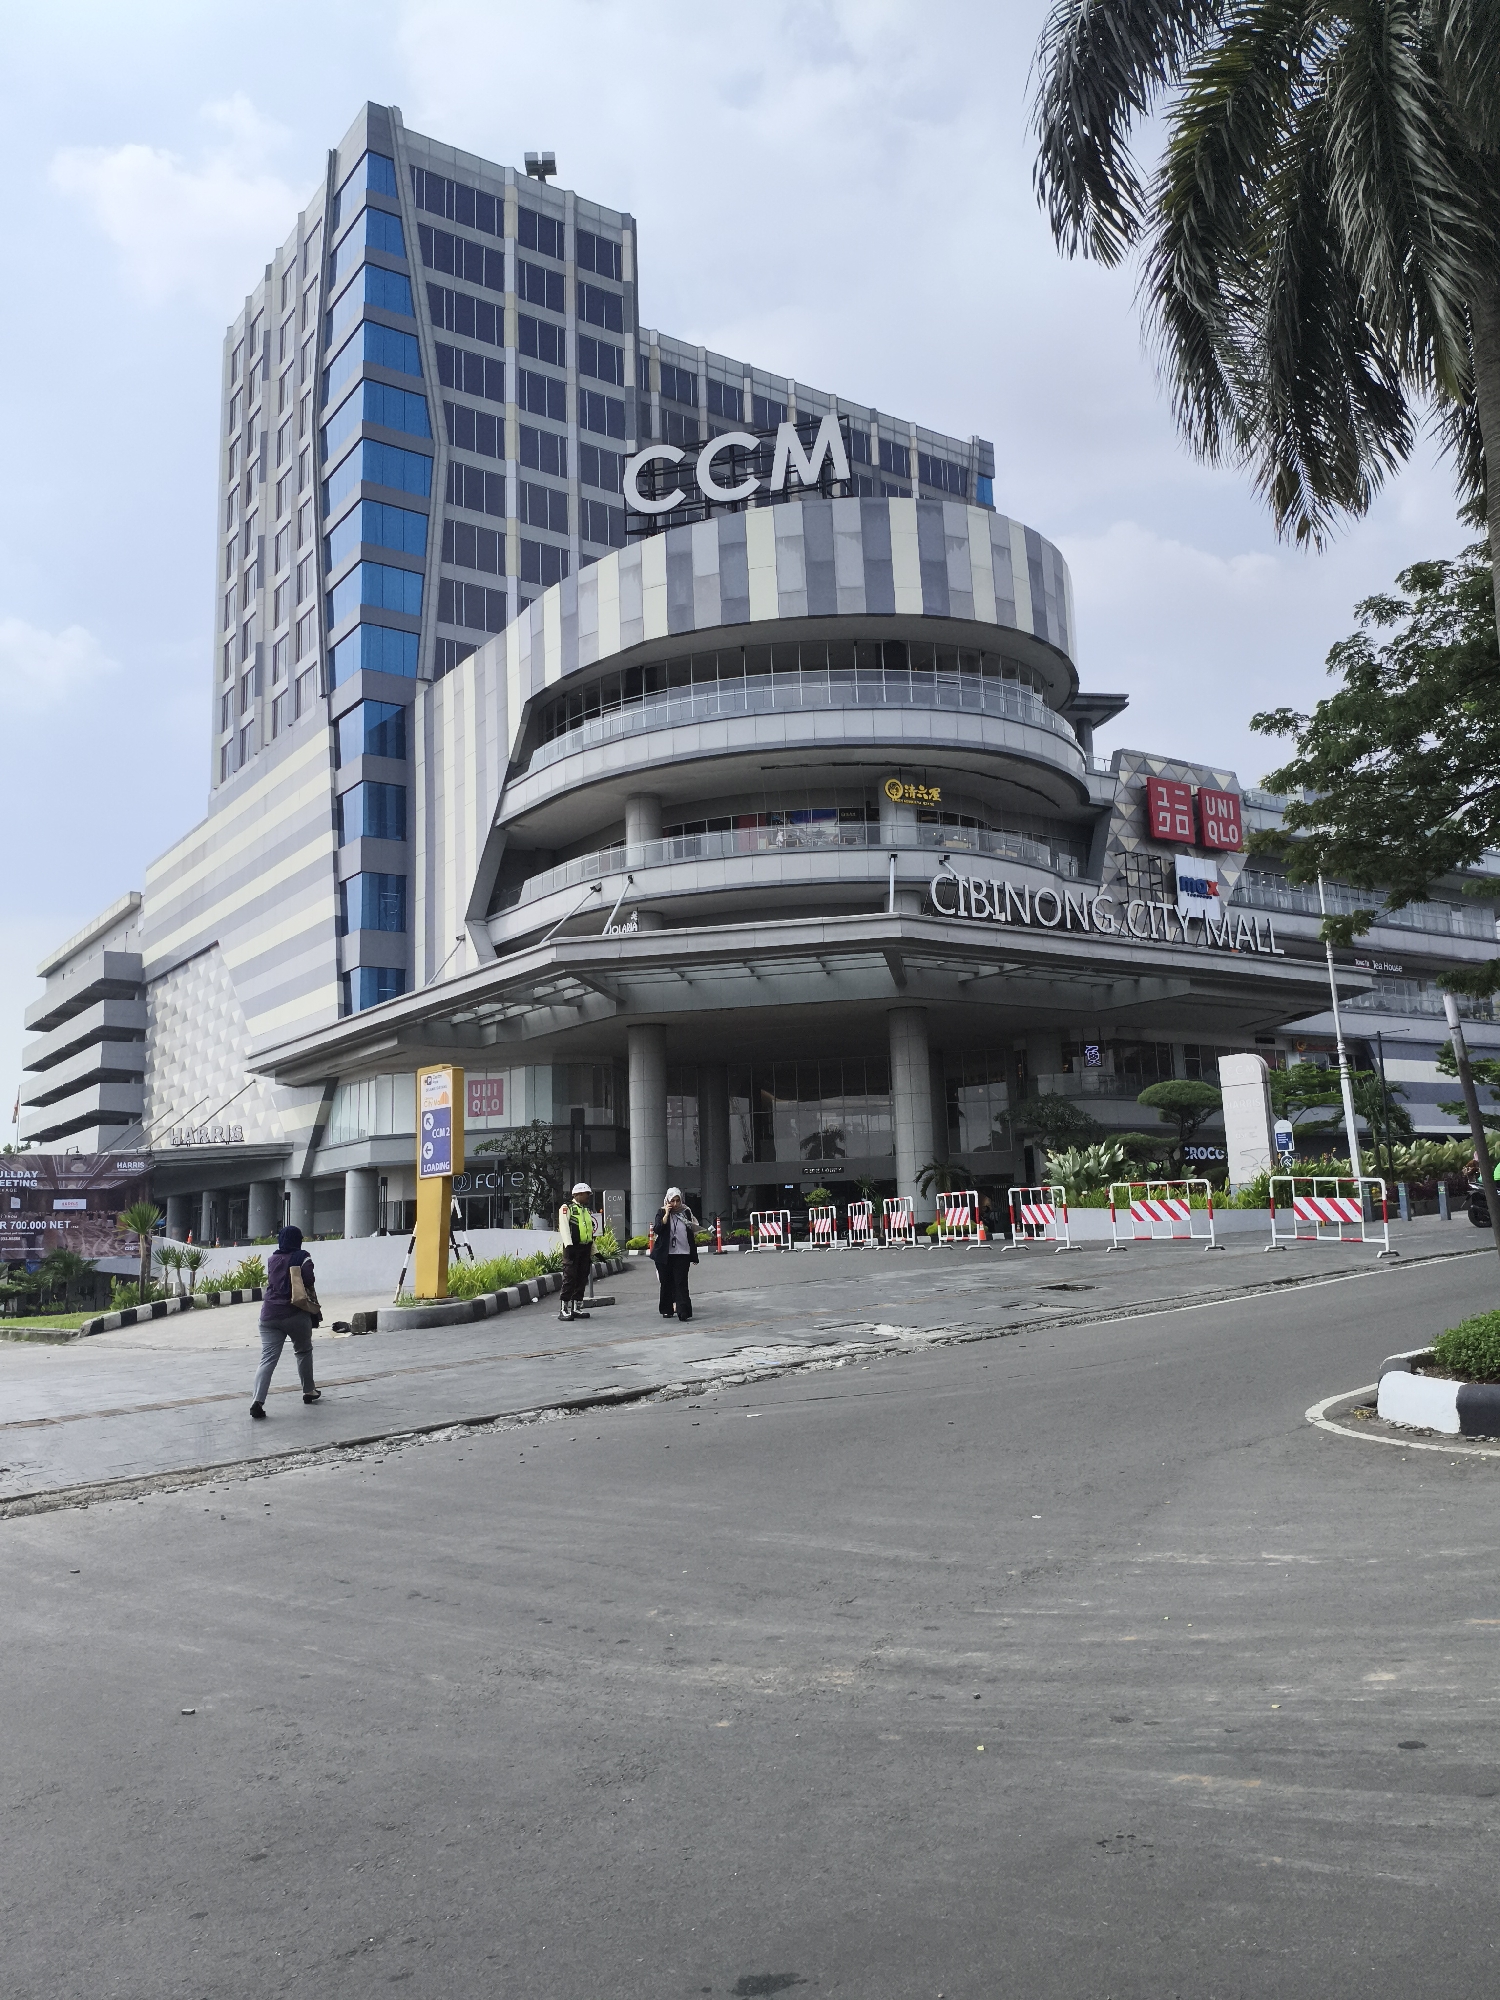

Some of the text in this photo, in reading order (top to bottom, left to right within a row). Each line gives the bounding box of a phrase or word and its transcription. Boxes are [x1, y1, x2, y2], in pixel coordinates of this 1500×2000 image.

[623, 414, 850, 514] CCM
[1206, 796, 1234, 820] UNI
[1208, 821, 1239, 844] QLO
[1179, 876, 1219, 896] max
[931, 873, 1285, 954] CIBINONG CITY MALL
[472, 1099, 500, 1115] QLO
[169, 1124, 245, 1146] HARRIS
[432, 1128, 450, 1138] CCM 2
[116, 1161, 145, 1169] HARRIS
[423, 1161, 450, 1173] LOADING
[10, 1221, 47, 1230] 700.000
[49, 1220, 71, 1229] NET
